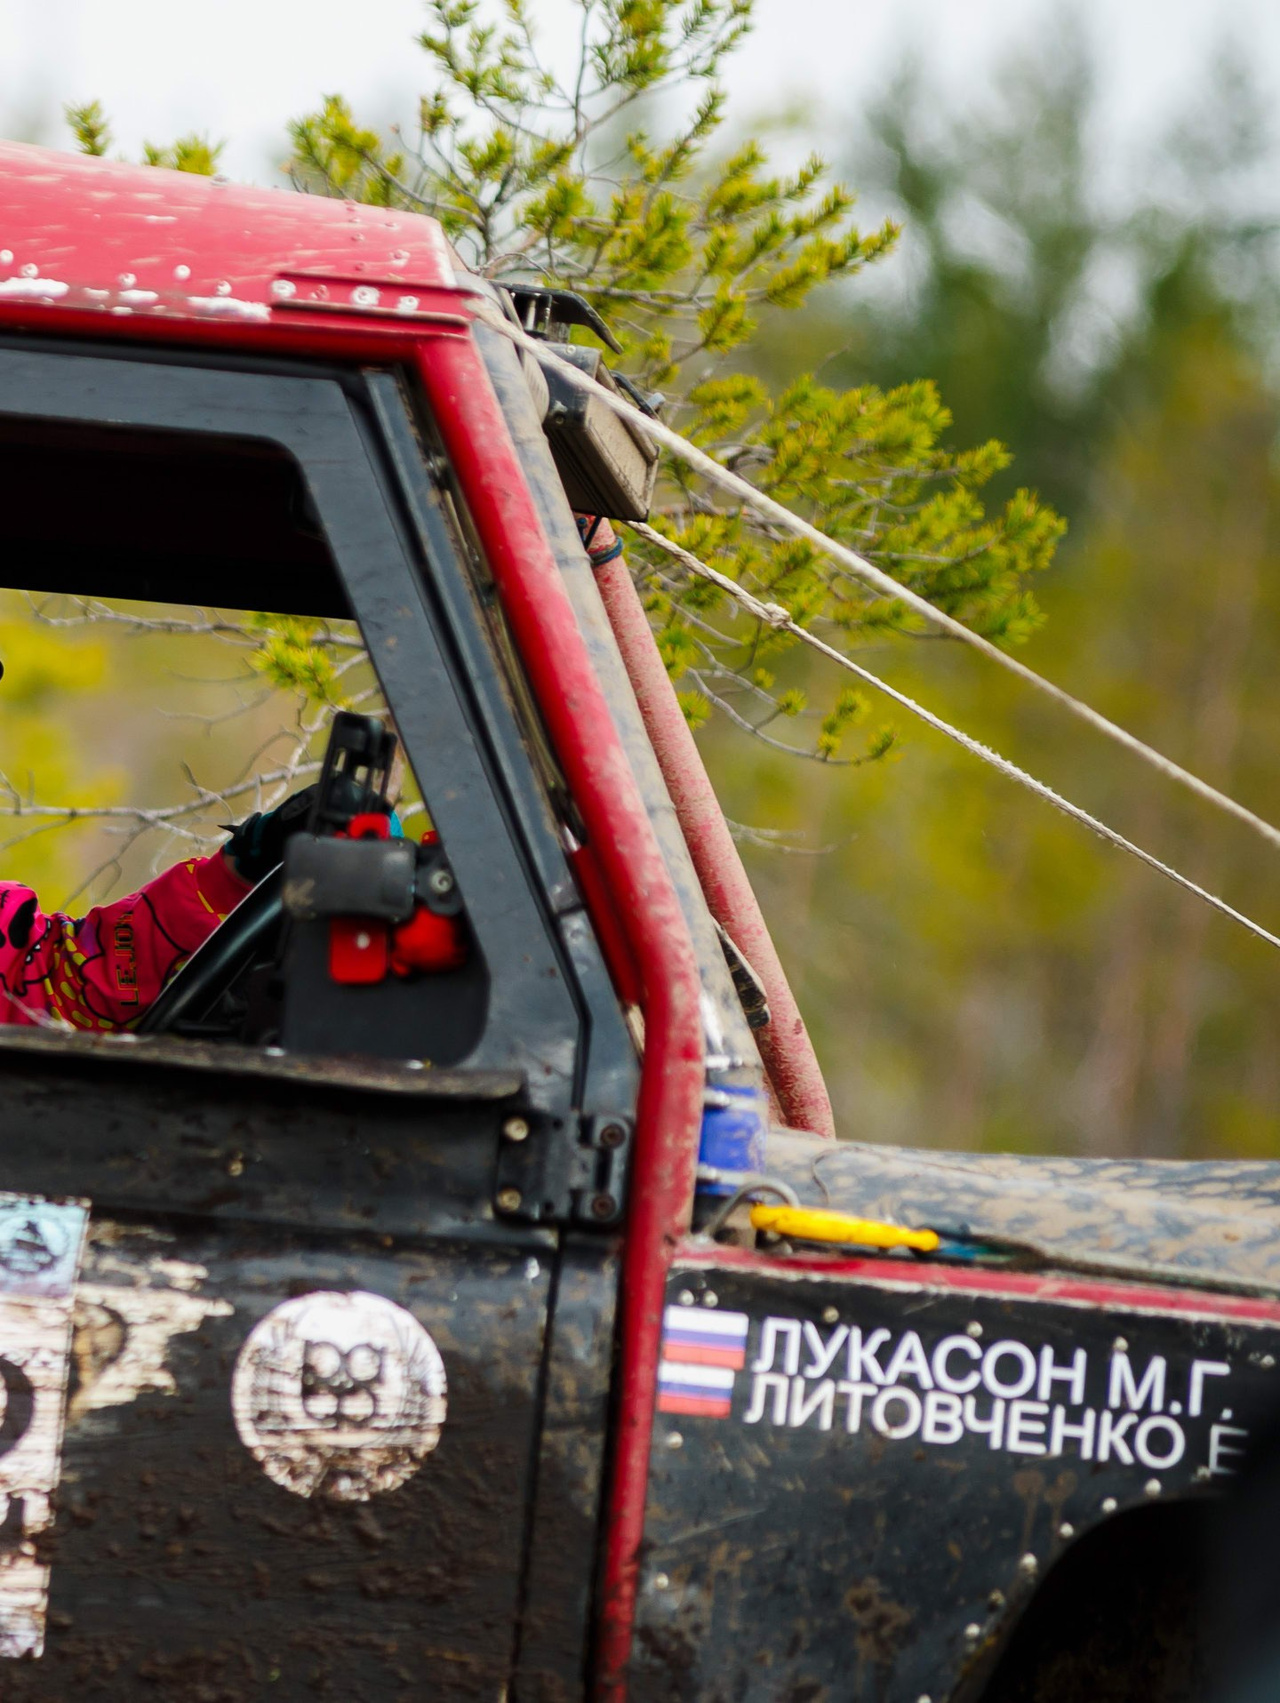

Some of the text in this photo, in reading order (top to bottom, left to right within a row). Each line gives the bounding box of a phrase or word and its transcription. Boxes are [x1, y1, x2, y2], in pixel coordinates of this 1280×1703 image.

[752, 1315, 1234, 1421] ЛУКАСОН М.Г.
[743, 1372, 1187, 1470] ЛИТОВЧЕНКО
